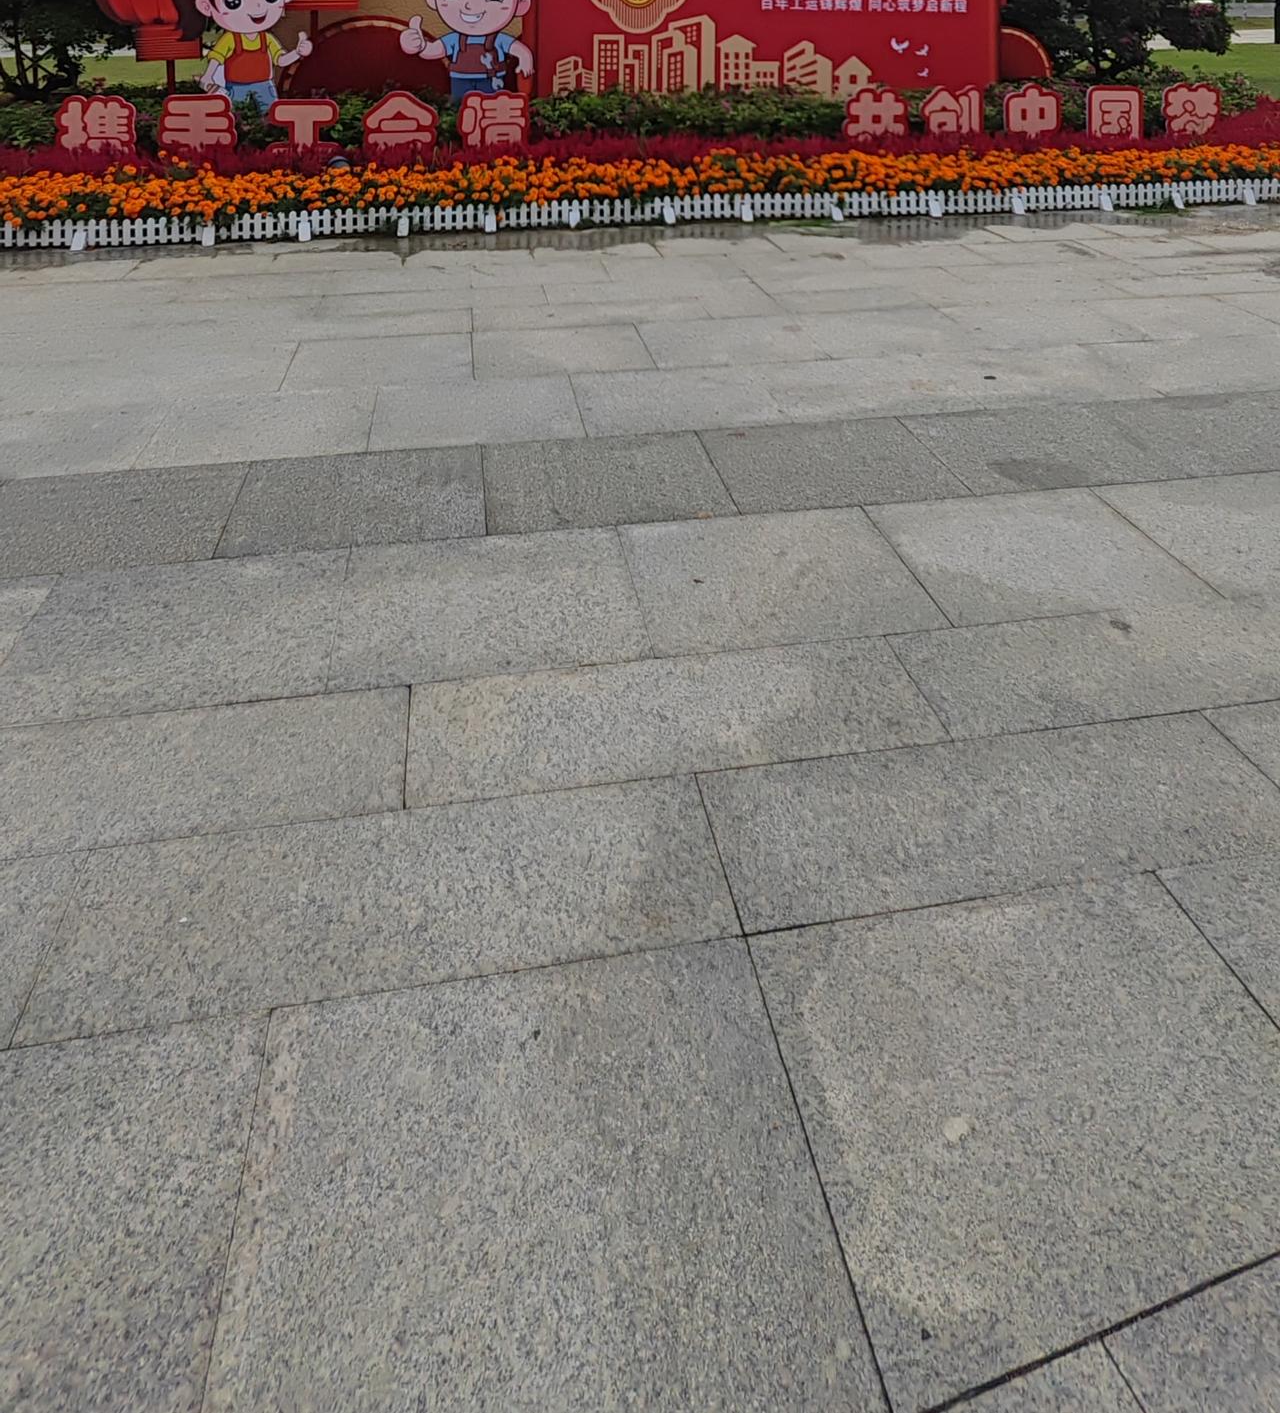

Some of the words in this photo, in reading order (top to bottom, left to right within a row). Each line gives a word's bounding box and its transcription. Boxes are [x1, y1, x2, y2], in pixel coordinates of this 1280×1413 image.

[845, 85, 1220, 139] 共创中国梦
